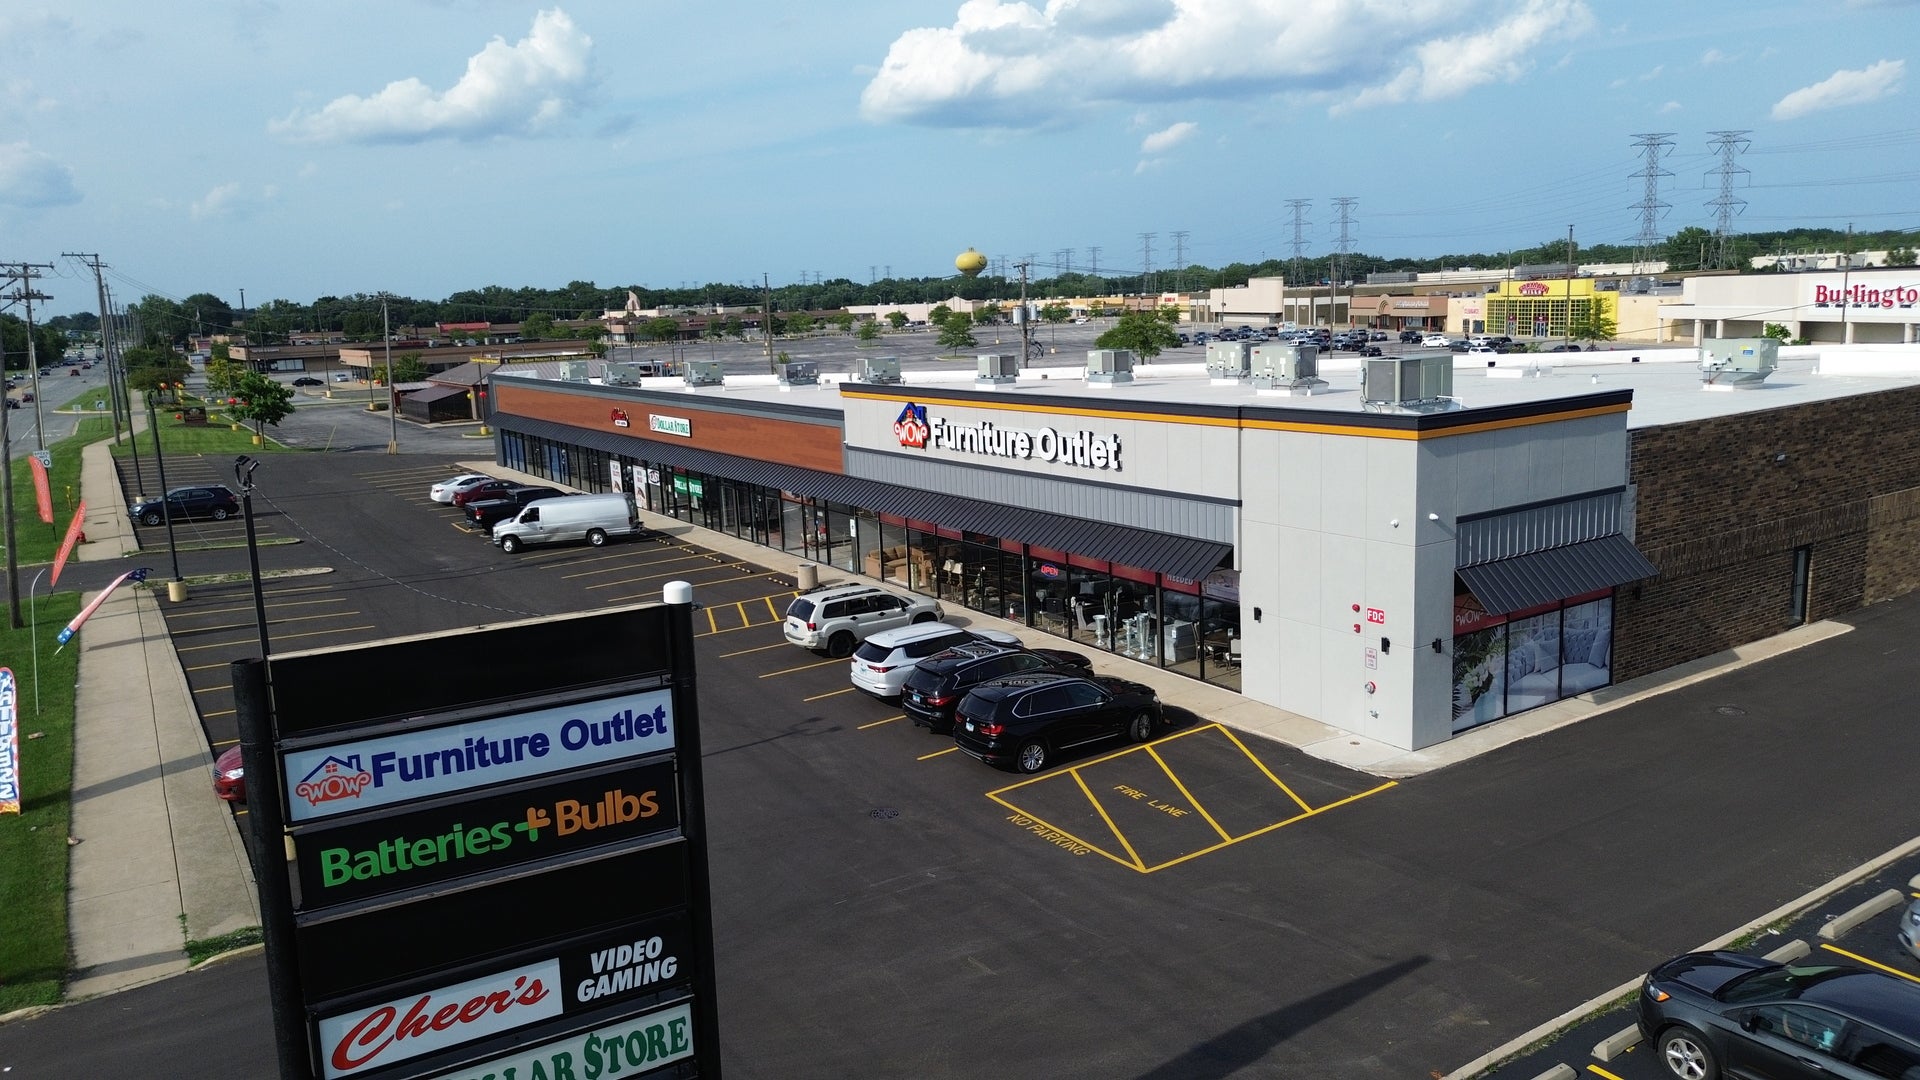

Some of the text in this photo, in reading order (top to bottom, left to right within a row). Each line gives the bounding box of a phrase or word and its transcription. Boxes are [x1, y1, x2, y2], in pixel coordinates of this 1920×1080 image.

[1815, 284, 1920, 309] Burlingto
[894, 421, 928, 444] WOW
[930, 416, 1122, 470] Furniture Outlet
[1041, 564, 1059, 576] OPEN
[1166, 574, 1194, 586] NEEDED
[1367, 610, 1384, 622] FDC
[1455, 610, 1483, 626] WOW
[371, 704, 668, 788] Furniture Outlet
[296, 771, 371, 803] WOW
[1113, 784, 1189, 818] FIRE LANE
[320, 822, 512, 888] Batteries
[555, 789, 659, 837] Bulbs
[1005, 814, 1091, 856] NO PARKING
[590, 936, 663, 975] VIDEO
[577, 956, 677, 1003] GAMING
[331, 976, 550, 1071] Cheer's
